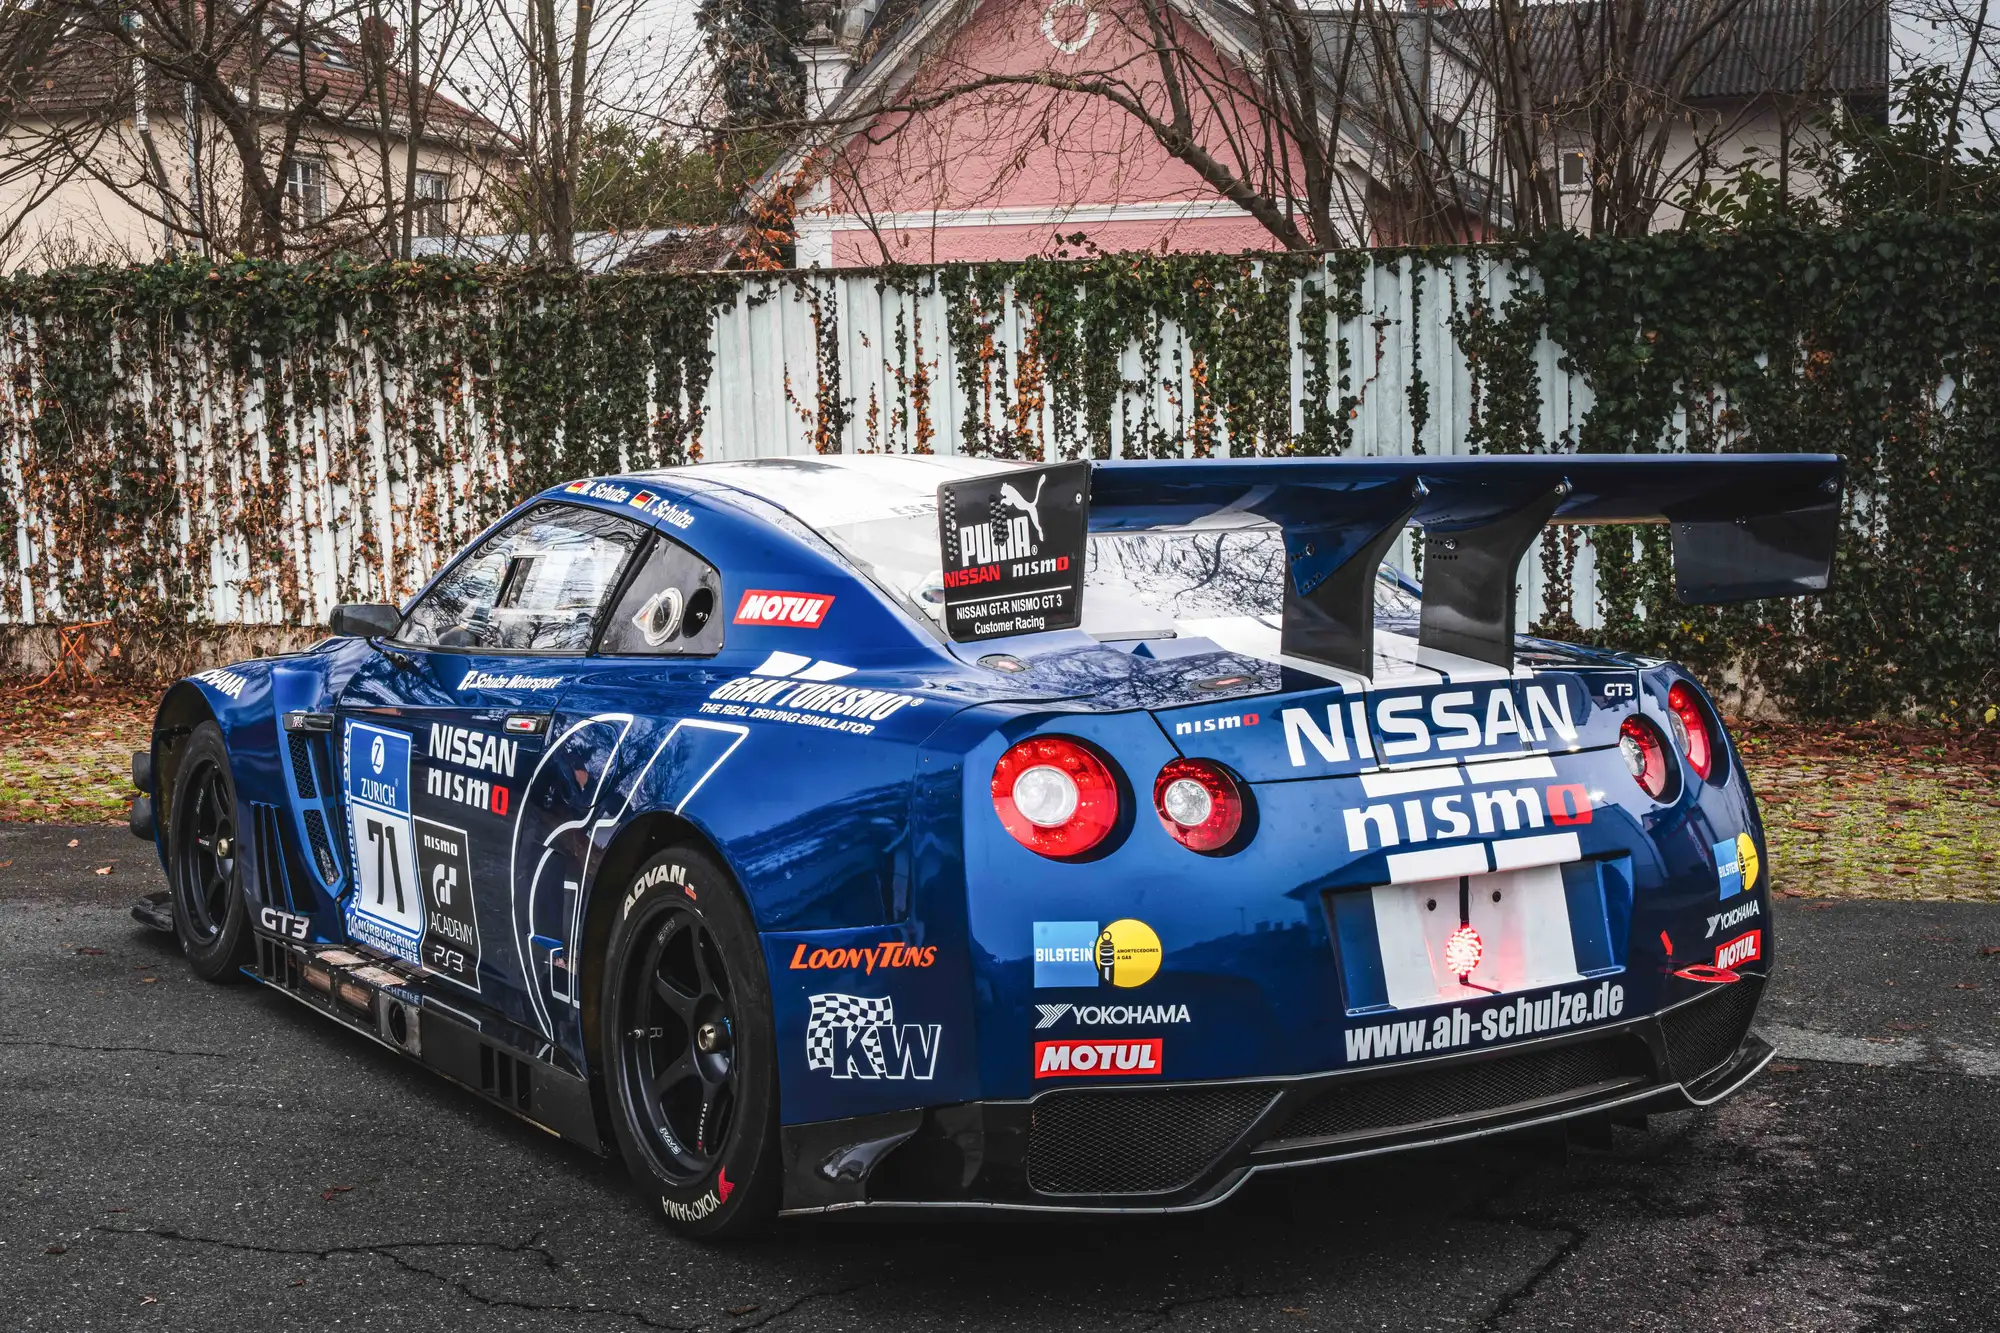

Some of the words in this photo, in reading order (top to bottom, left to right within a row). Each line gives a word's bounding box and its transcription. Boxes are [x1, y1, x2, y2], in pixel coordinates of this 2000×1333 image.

[590, 483, 630, 503] Schulze
[652, 499, 694, 529] Schulze
[944, 564, 1001, 588] NISSAN
[1012, 556, 1069, 578] nismo
[738, 595, 825, 623] MOTUL
[957, 603, 988, 620] NISSAN
[989, 601, 1010, 616] GT-R
[1012, 597, 1040, 613] NISMO
[1042, 595, 1055, 609] GT
[1056, 594, 1063, 607] 3
[975, 620, 1014, 635] Customer
[1016, 615, 1045, 630] Racing
[505, 675, 564, 692] Motorsport
[709, 677, 798, 704] GRAN
[776, 683, 914, 721] TURISMO
[1604, 683, 1633, 697] GT3
[699, 702, 722, 714] THE
[721, 706, 750, 717] REAL
[749, 708, 801, 723] DRIVING
[797, 715, 875, 735] SIMULATOR
[1176, 713, 1260, 735] nismo
[1282, 684, 1578, 767] NISSAN
[429, 722, 518, 778] NISSAN
[361, 778, 396, 807] ZURICH
[427, 767, 509, 816] nismo
[1342, 783, 1593, 853] nismo
[424, 834, 458, 857] nismo
[367, 818, 405, 914] 71
[624, 864, 686, 920] ADVAN
[261, 907, 310, 940] GT3
[430, 911, 473, 946] ACADEMY
[1720, 899, 1760, 931] YOKOHAMA
[358, 919, 417, 952] NÜRBURGRING
[358, 930, 420, 965] NORDSCHLEIFE
[434, 945, 464, 973] PS3
[1036, 947, 1094, 962] BILSTEIN
[1717, 935, 1757, 970] MOTUL
[1072, 1004, 1191, 1025] YOKOHAMA
[1344, 981, 1624, 1062] www.ah-schulze.de
[831, 1024, 942, 1080] KW
[1039, 1044, 1157, 1072] MOTUL
[662, 1189, 721, 1222] YOKOHAMA
